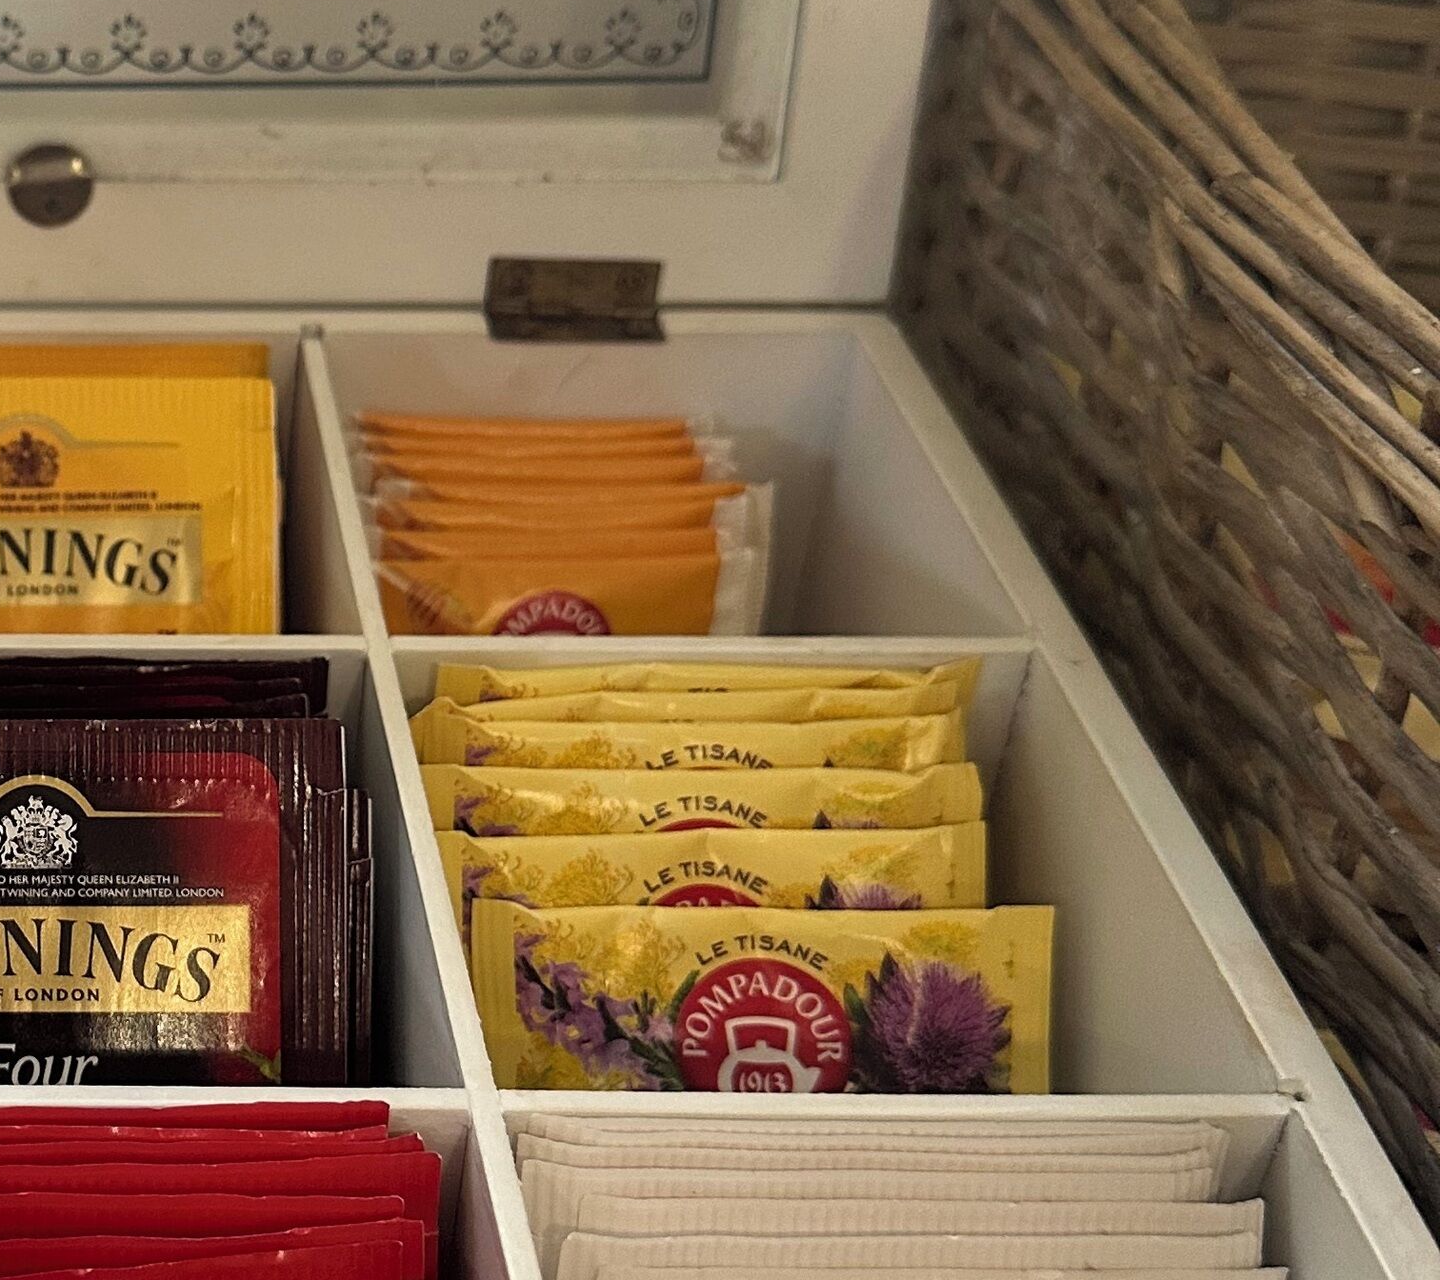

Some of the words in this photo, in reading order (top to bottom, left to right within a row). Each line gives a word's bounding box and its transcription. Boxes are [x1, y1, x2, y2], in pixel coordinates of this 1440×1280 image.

[7, 583, 79, 597] LONDON
[501, 597, 601, 634] MPADO
[645, 750, 679, 770] LE
[639, 802, 671, 827] LE
[678, 796, 768, 828] TISANE
[9, 875, 28, 884] HER
[32, 875, 75, 886] MAJESTY
[77, 875, 113, 885] QUEEN
[116, 875, 170, 884] ELIZABETH
[644, 867, 675, 893] LE
[678, 861, 768, 895] TISANE
[0, 888, 48, 897] TWINING
[51, 888, 75, 897] AND
[78, 888, 130, 898] COMPANY
[695, 940, 728, 965] LE
[734, 935, 829, 971] TISANE
[15, 988, 100, 1002] LONDON
[682, 971, 843, 1062] POMPADOUR
